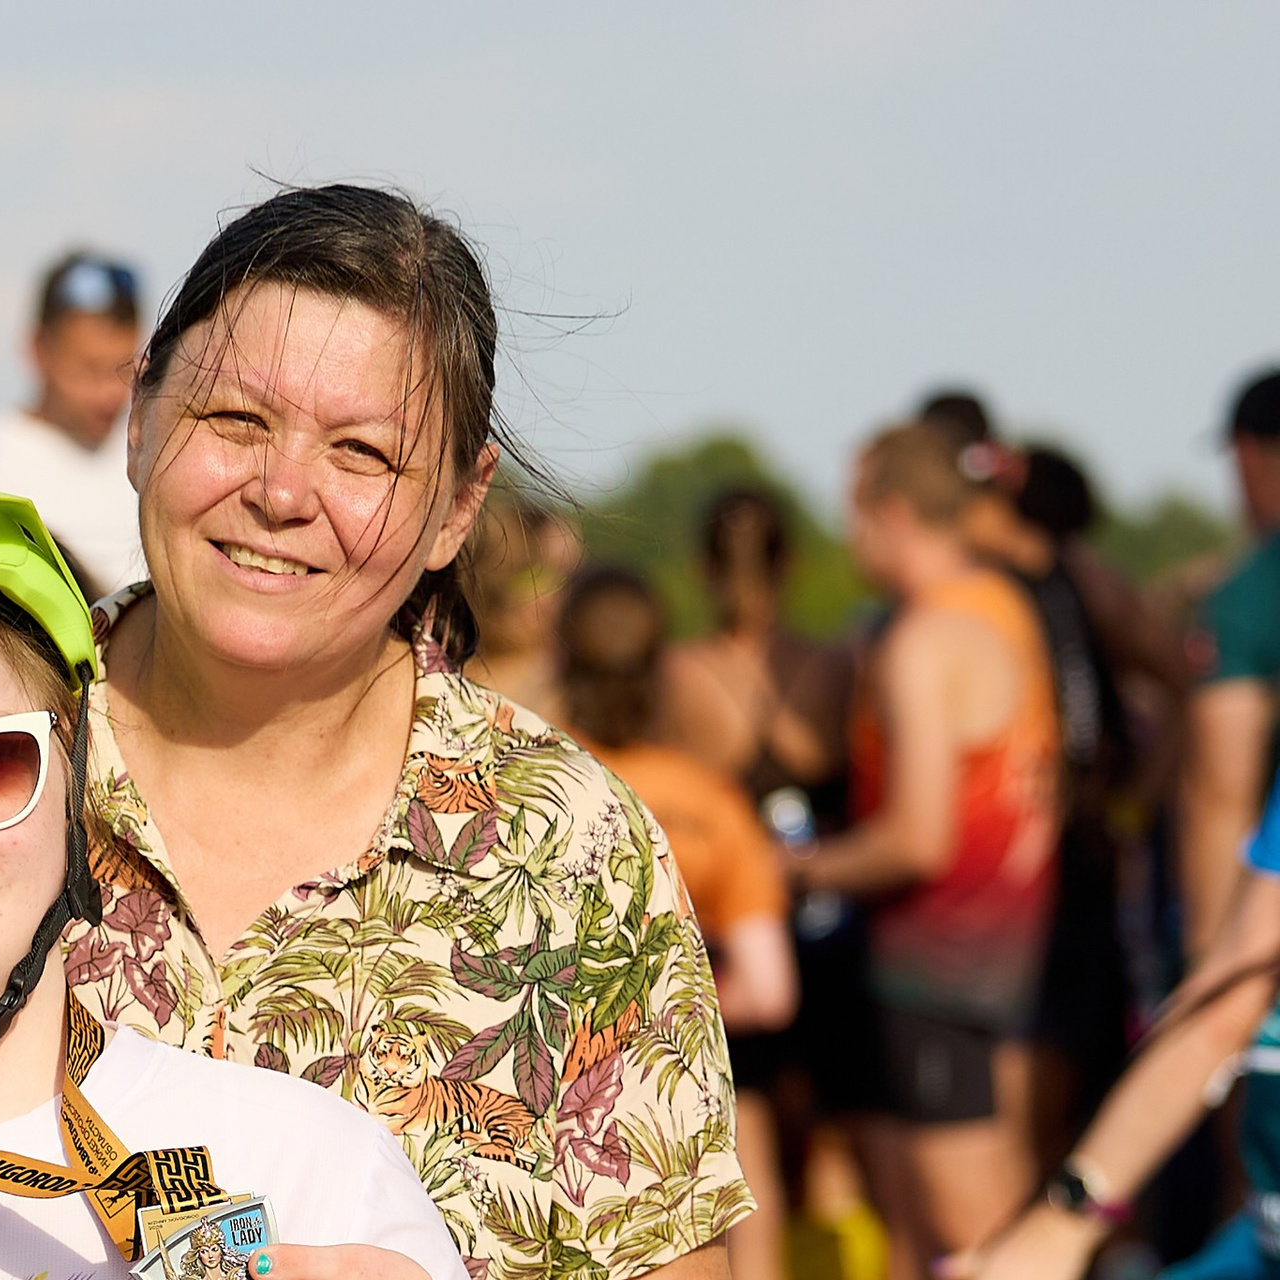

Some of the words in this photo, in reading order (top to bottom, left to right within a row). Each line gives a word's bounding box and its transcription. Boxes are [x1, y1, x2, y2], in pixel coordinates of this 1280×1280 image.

[85, 1116, 118, 1161] ОБЛАСТИ
[229, 1216, 253, 1231] IRON
[231, 1227, 263, 1246] LADY
